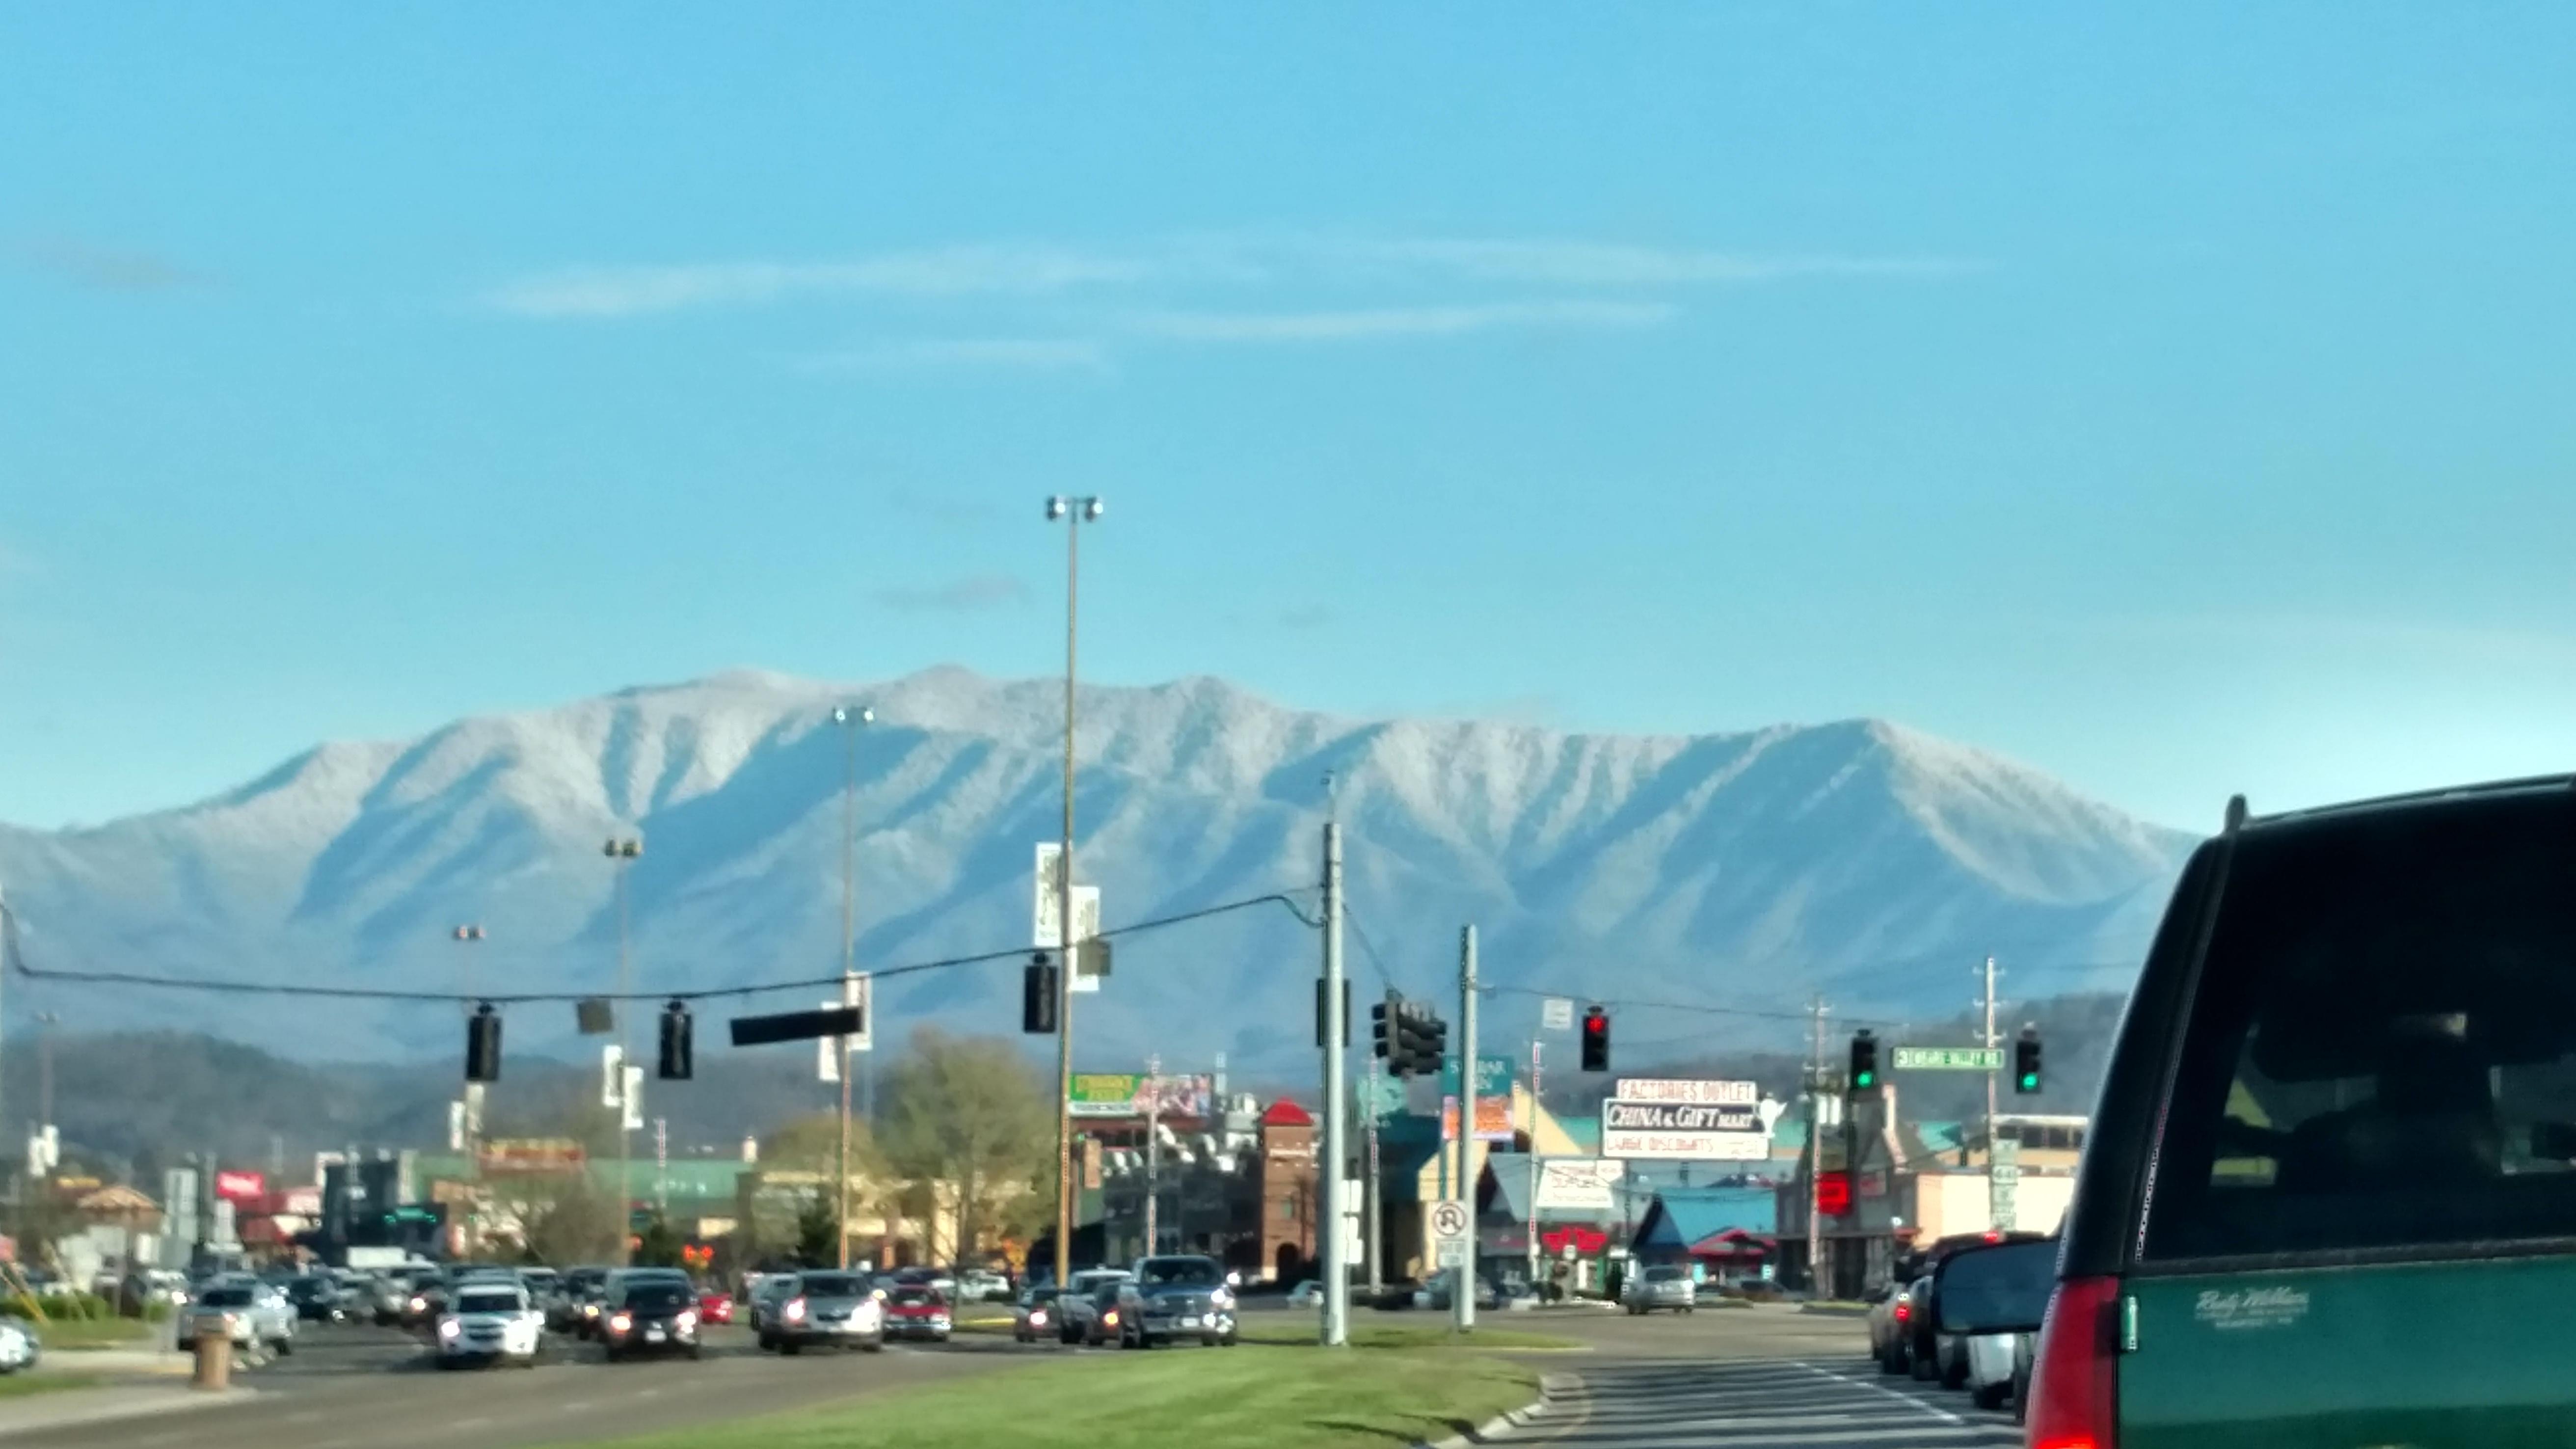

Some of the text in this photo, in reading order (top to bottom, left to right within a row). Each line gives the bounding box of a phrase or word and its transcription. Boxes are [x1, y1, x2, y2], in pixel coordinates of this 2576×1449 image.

[1703, 1082, 1751, 1101] OUTLET
[1609, 1104, 1663, 1127] CHINA
[1676, 1105, 1719, 1127] GIFT
